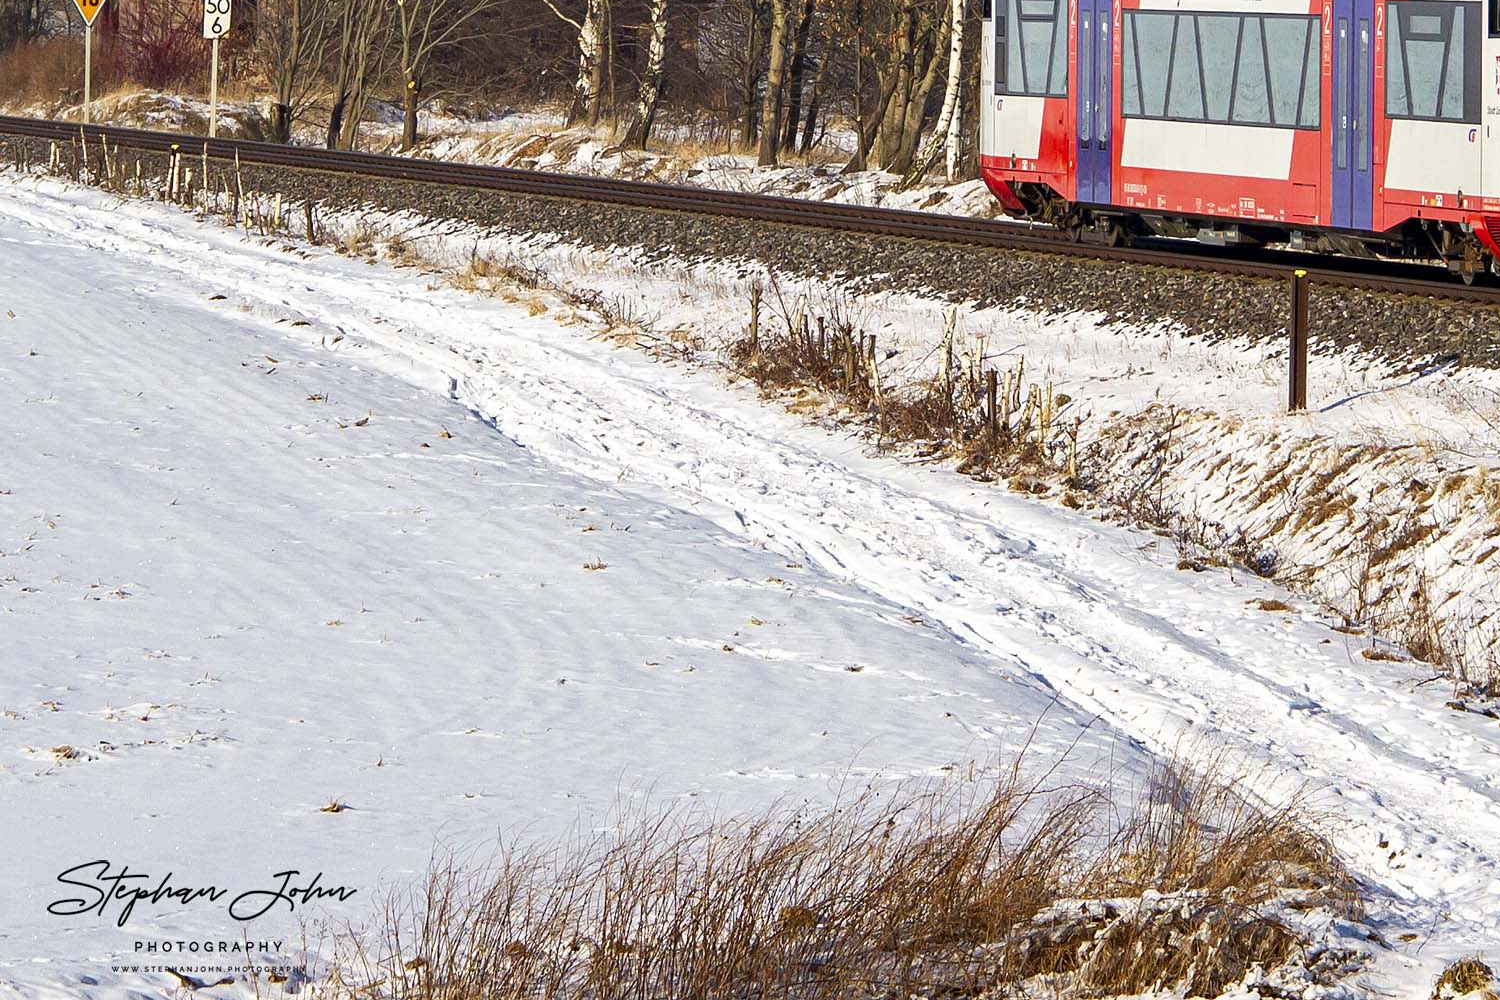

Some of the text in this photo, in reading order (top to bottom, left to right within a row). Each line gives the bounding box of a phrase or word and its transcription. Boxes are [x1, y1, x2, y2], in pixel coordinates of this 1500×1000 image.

[211, 16, 223, 34] 6
[1114, 0, 1120, 27] 2
[1324, 5, 1330, 35] 2
[1377, 6, 1383, 36] 2
